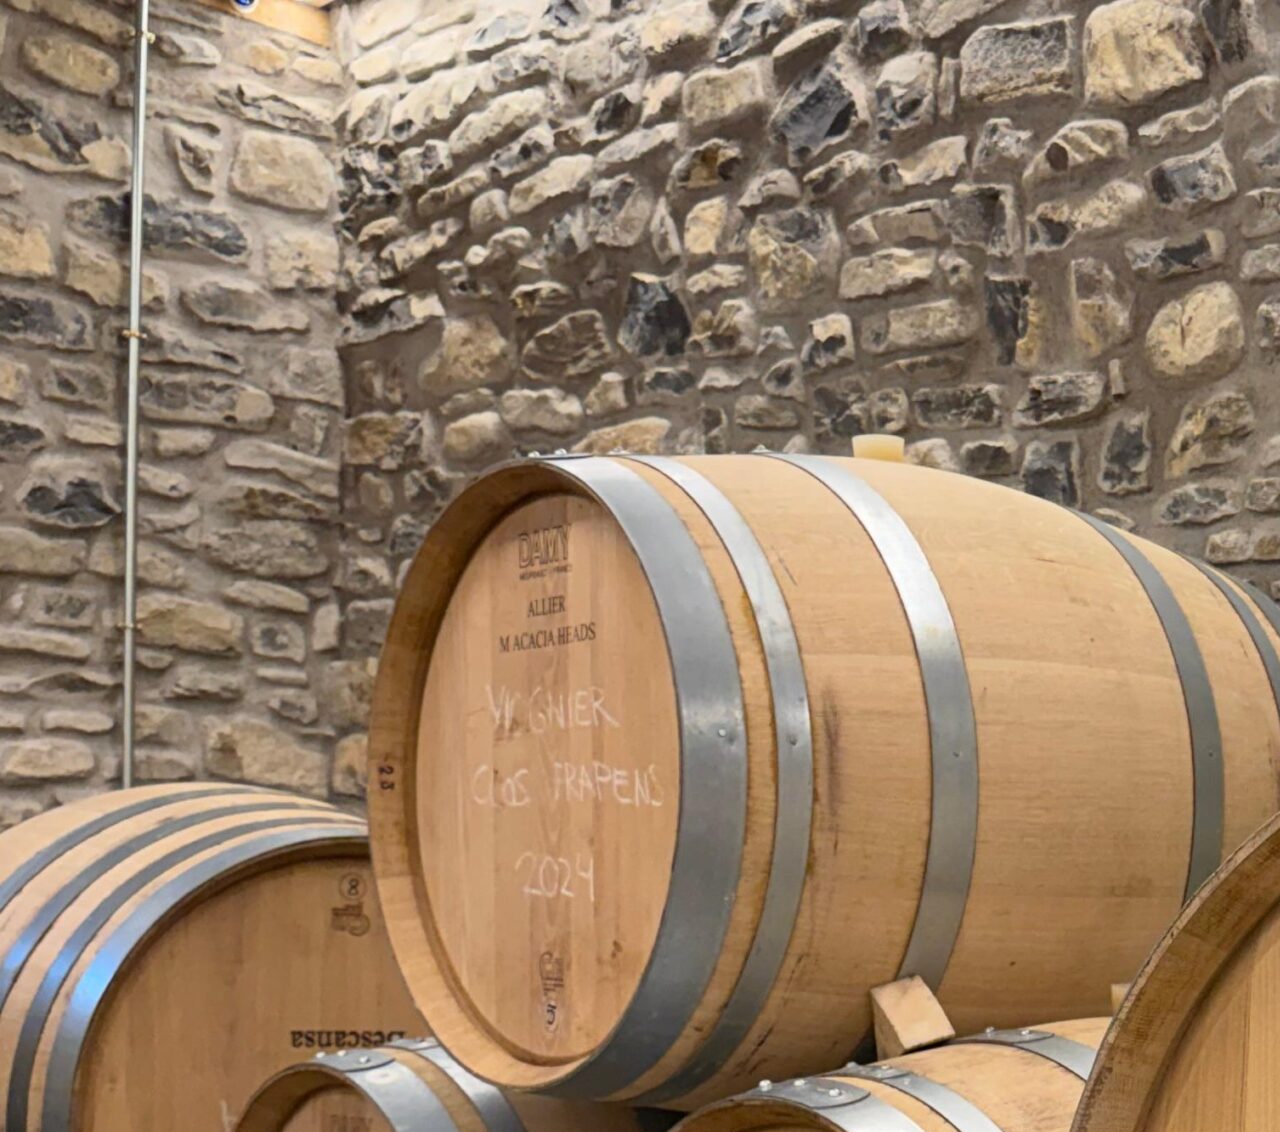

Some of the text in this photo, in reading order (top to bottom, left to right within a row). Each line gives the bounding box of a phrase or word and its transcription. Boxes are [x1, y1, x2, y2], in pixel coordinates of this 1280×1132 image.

[518, 524, 571, 568] DAMY
[527, 595, 566, 618] ALLIER
[512, 629, 555, 651] ACACIA
[557, 621, 597, 645] HEADS
[514, 852, 595, 902] 2024
